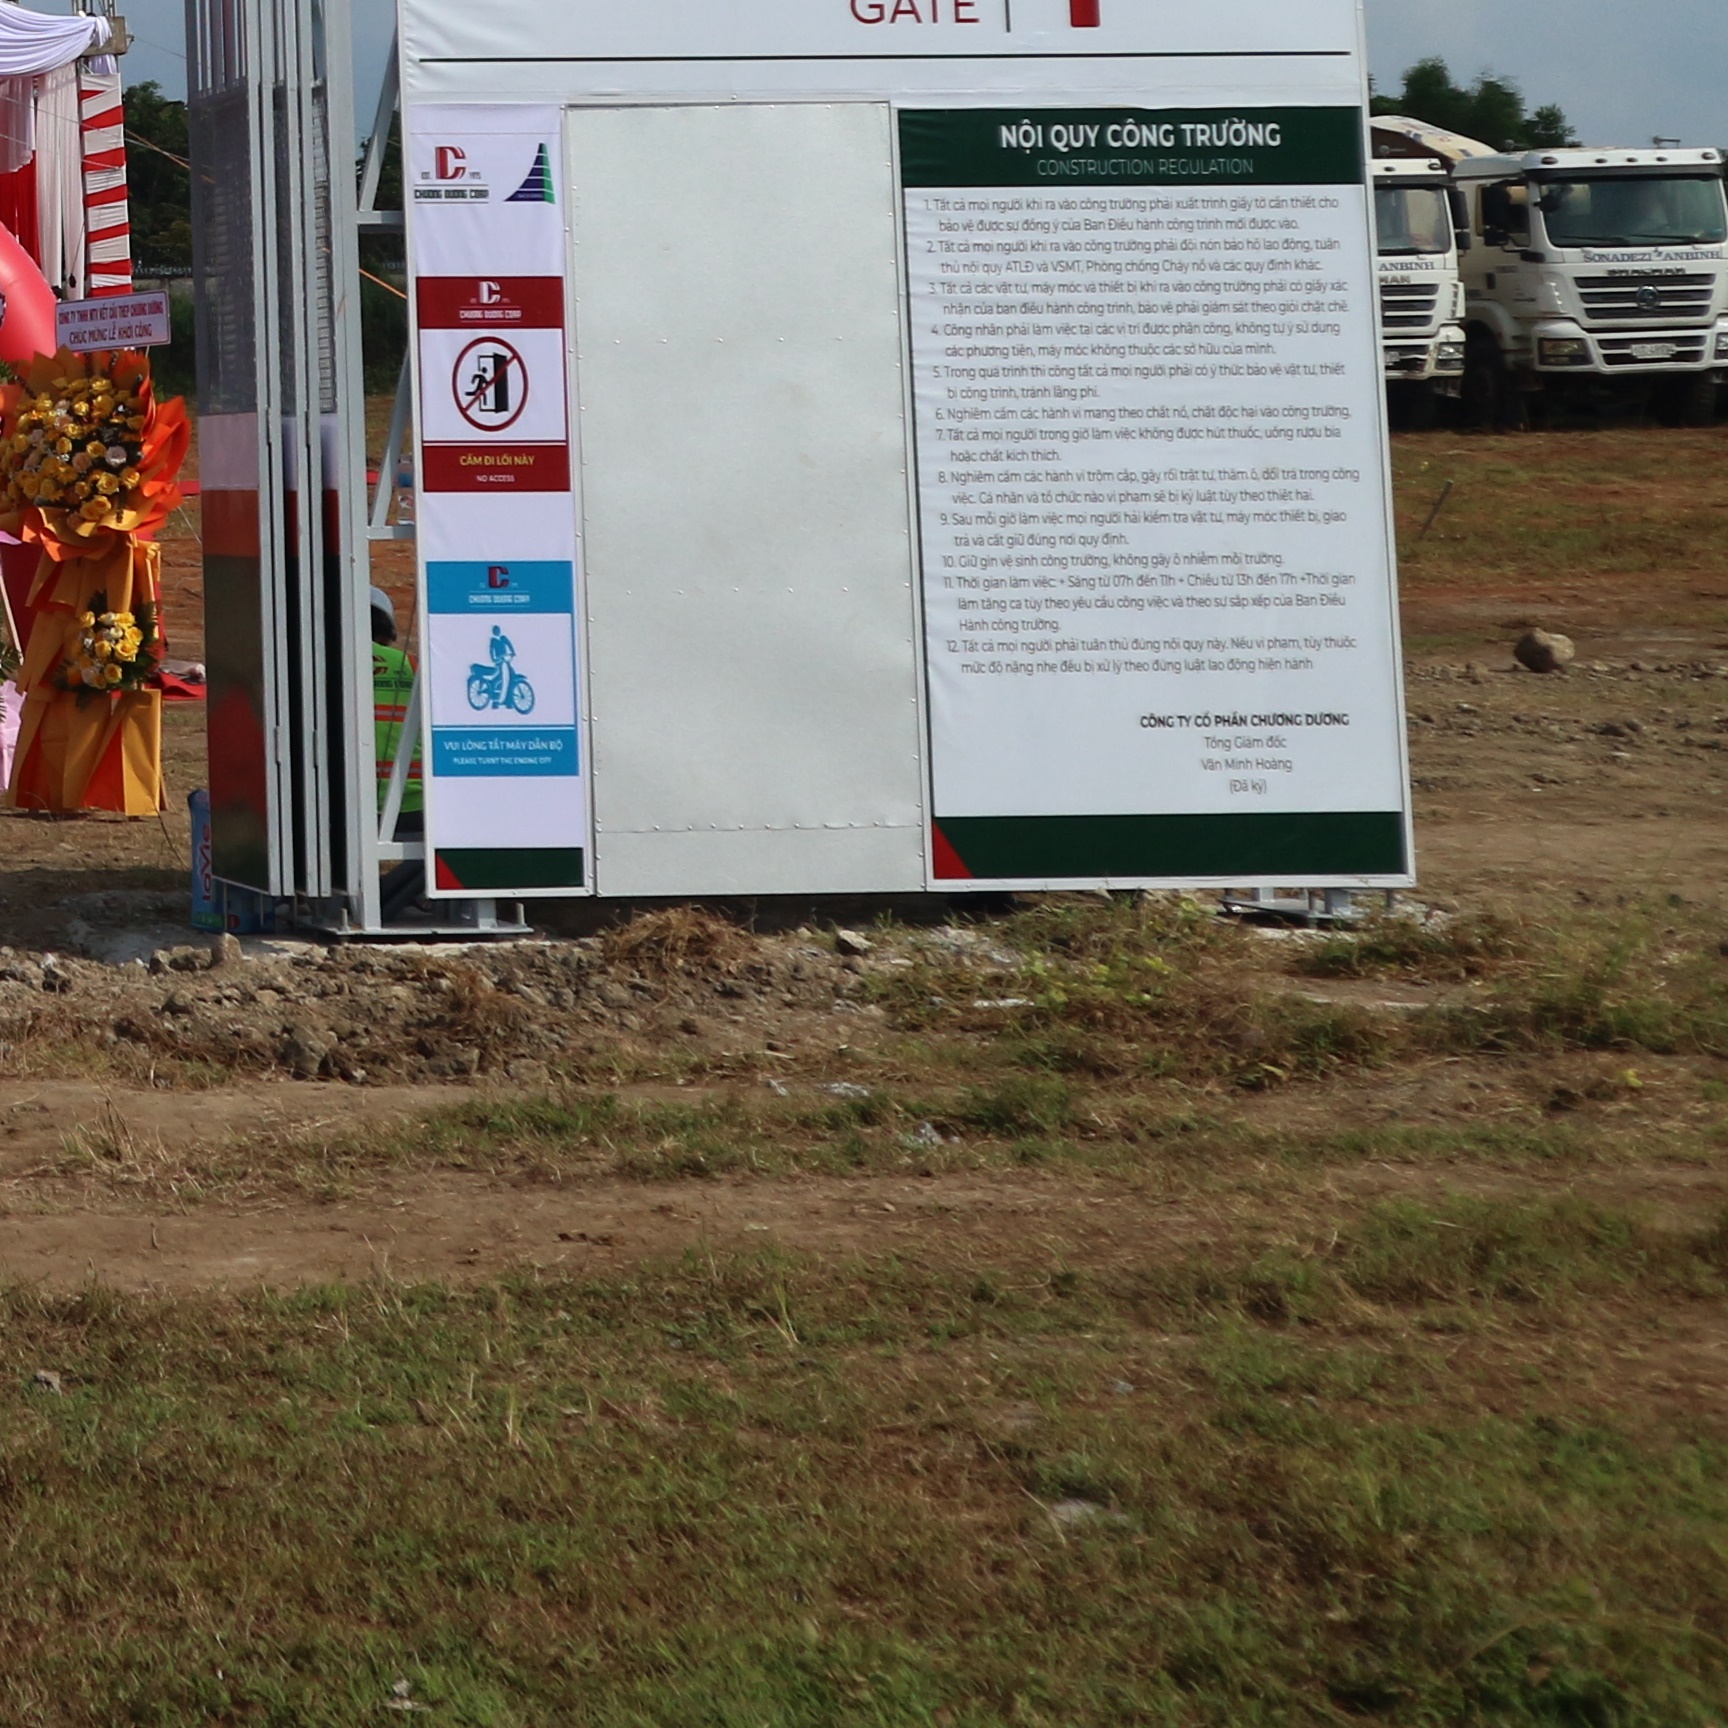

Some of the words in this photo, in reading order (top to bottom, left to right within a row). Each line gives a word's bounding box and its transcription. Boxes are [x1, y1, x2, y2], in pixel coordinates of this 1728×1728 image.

[1001, 119, 1042, 154] NỘI
[1050, 125, 1099, 152] QUY
[1107, 119, 1174, 147] CÔNG
[1180, 118, 1280, 146] TRƯỜNG
[1038, 159, 1153, 175] CONSTRUCTION
[1159, 159, 1253, 174] REGULATION
[1584, 253, 1652, 263] SONADEZI
[1663, 251, 1721, 260] ANBINH
[1379, 262, 1434, 271] ANBINH
[460, 453, 482, 466] CẤM
[484, 456, 495, 466] ĐI
[497, 453, 512, 466] LỐI
[514, 453, 535, 465] NÀY
